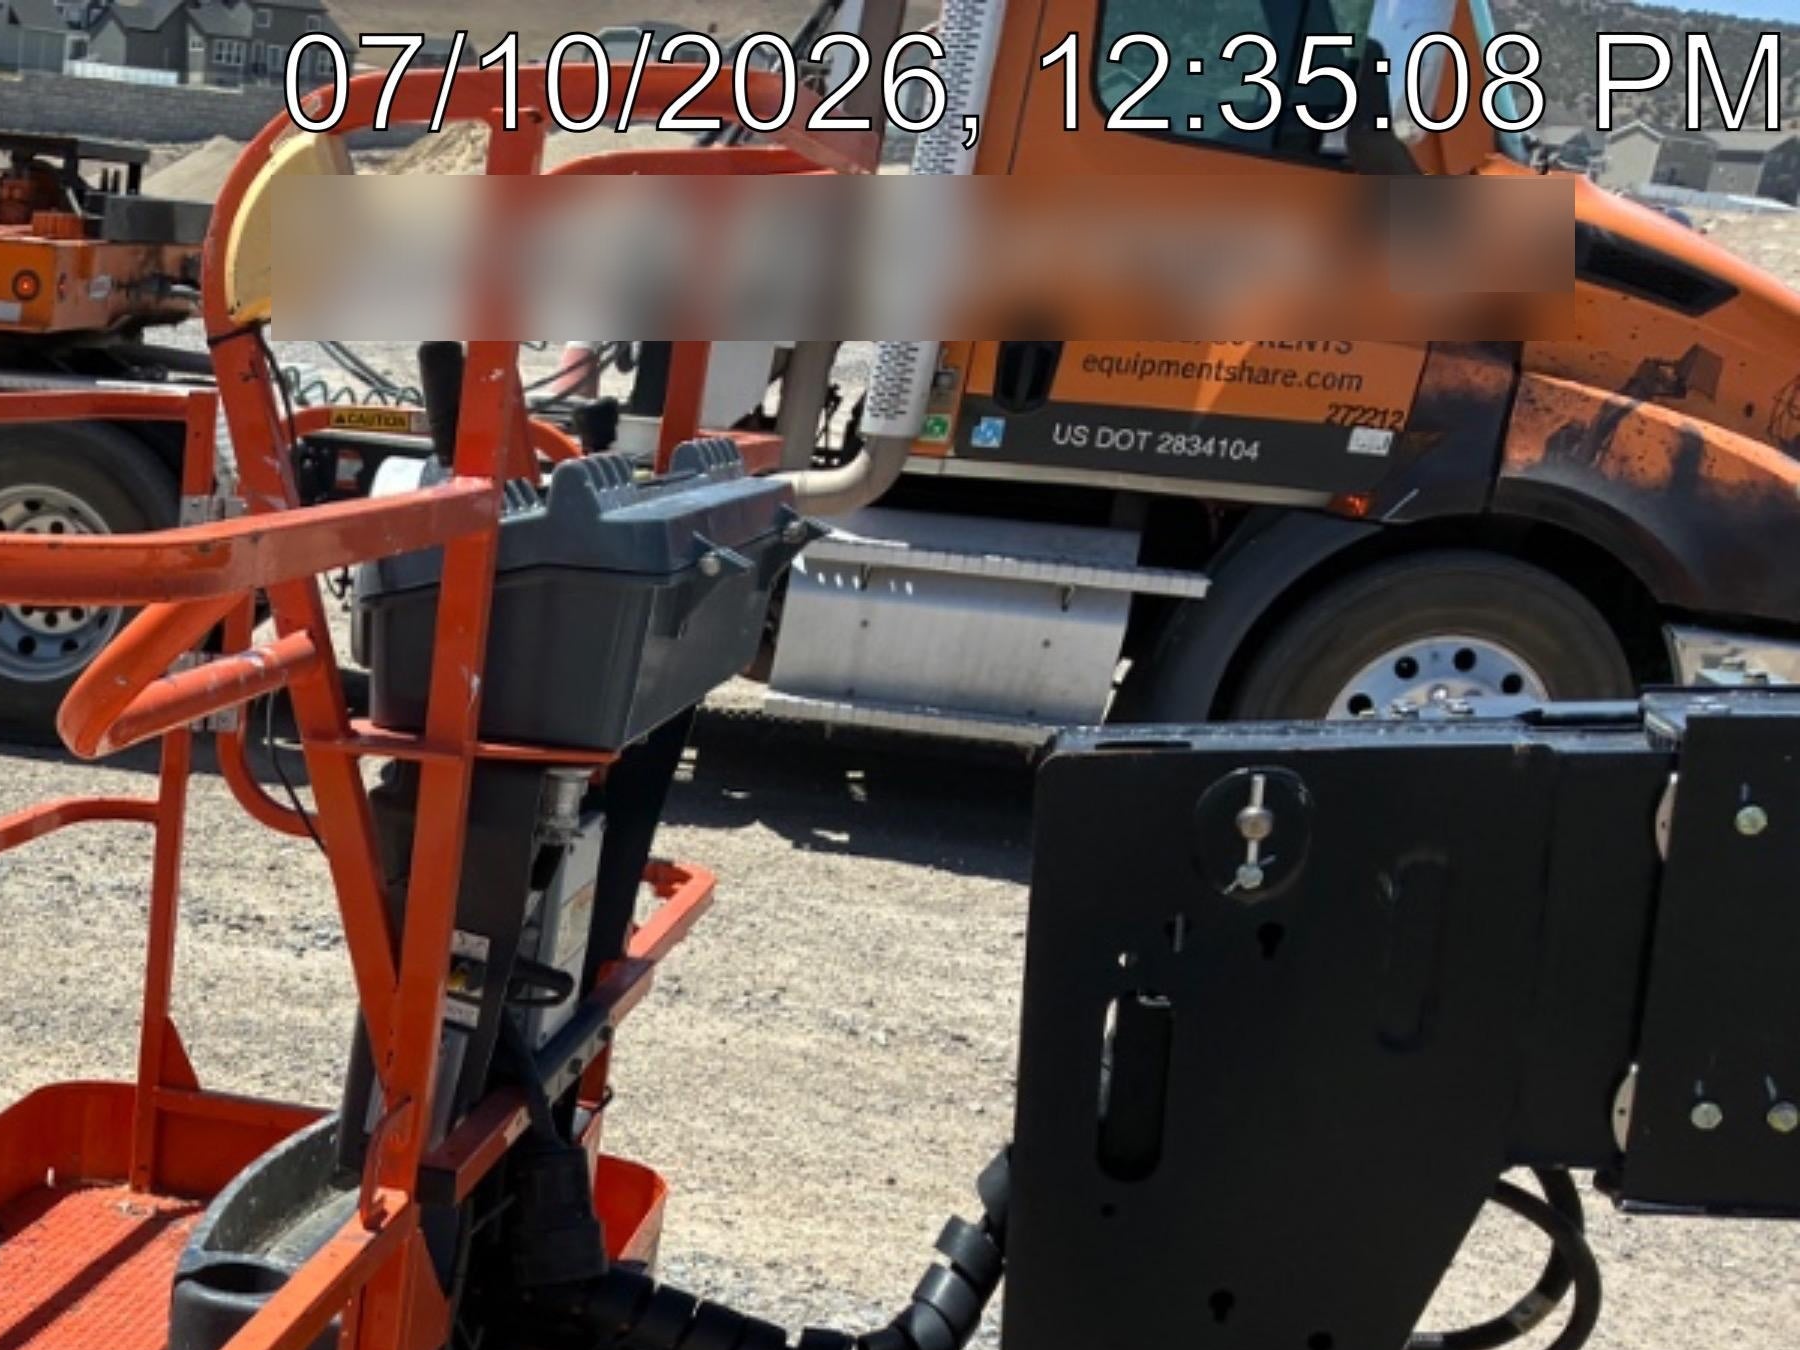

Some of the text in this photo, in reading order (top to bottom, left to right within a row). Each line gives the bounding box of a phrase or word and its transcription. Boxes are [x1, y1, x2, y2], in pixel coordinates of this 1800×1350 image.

[1082, 351, 1364, 392] equipmentshare.com
[347, 412, 406, 427] CAUTION
[1325, 402, 1405, 432] 272212
[1052, 422, 1261, 461] US DOT 2834104
